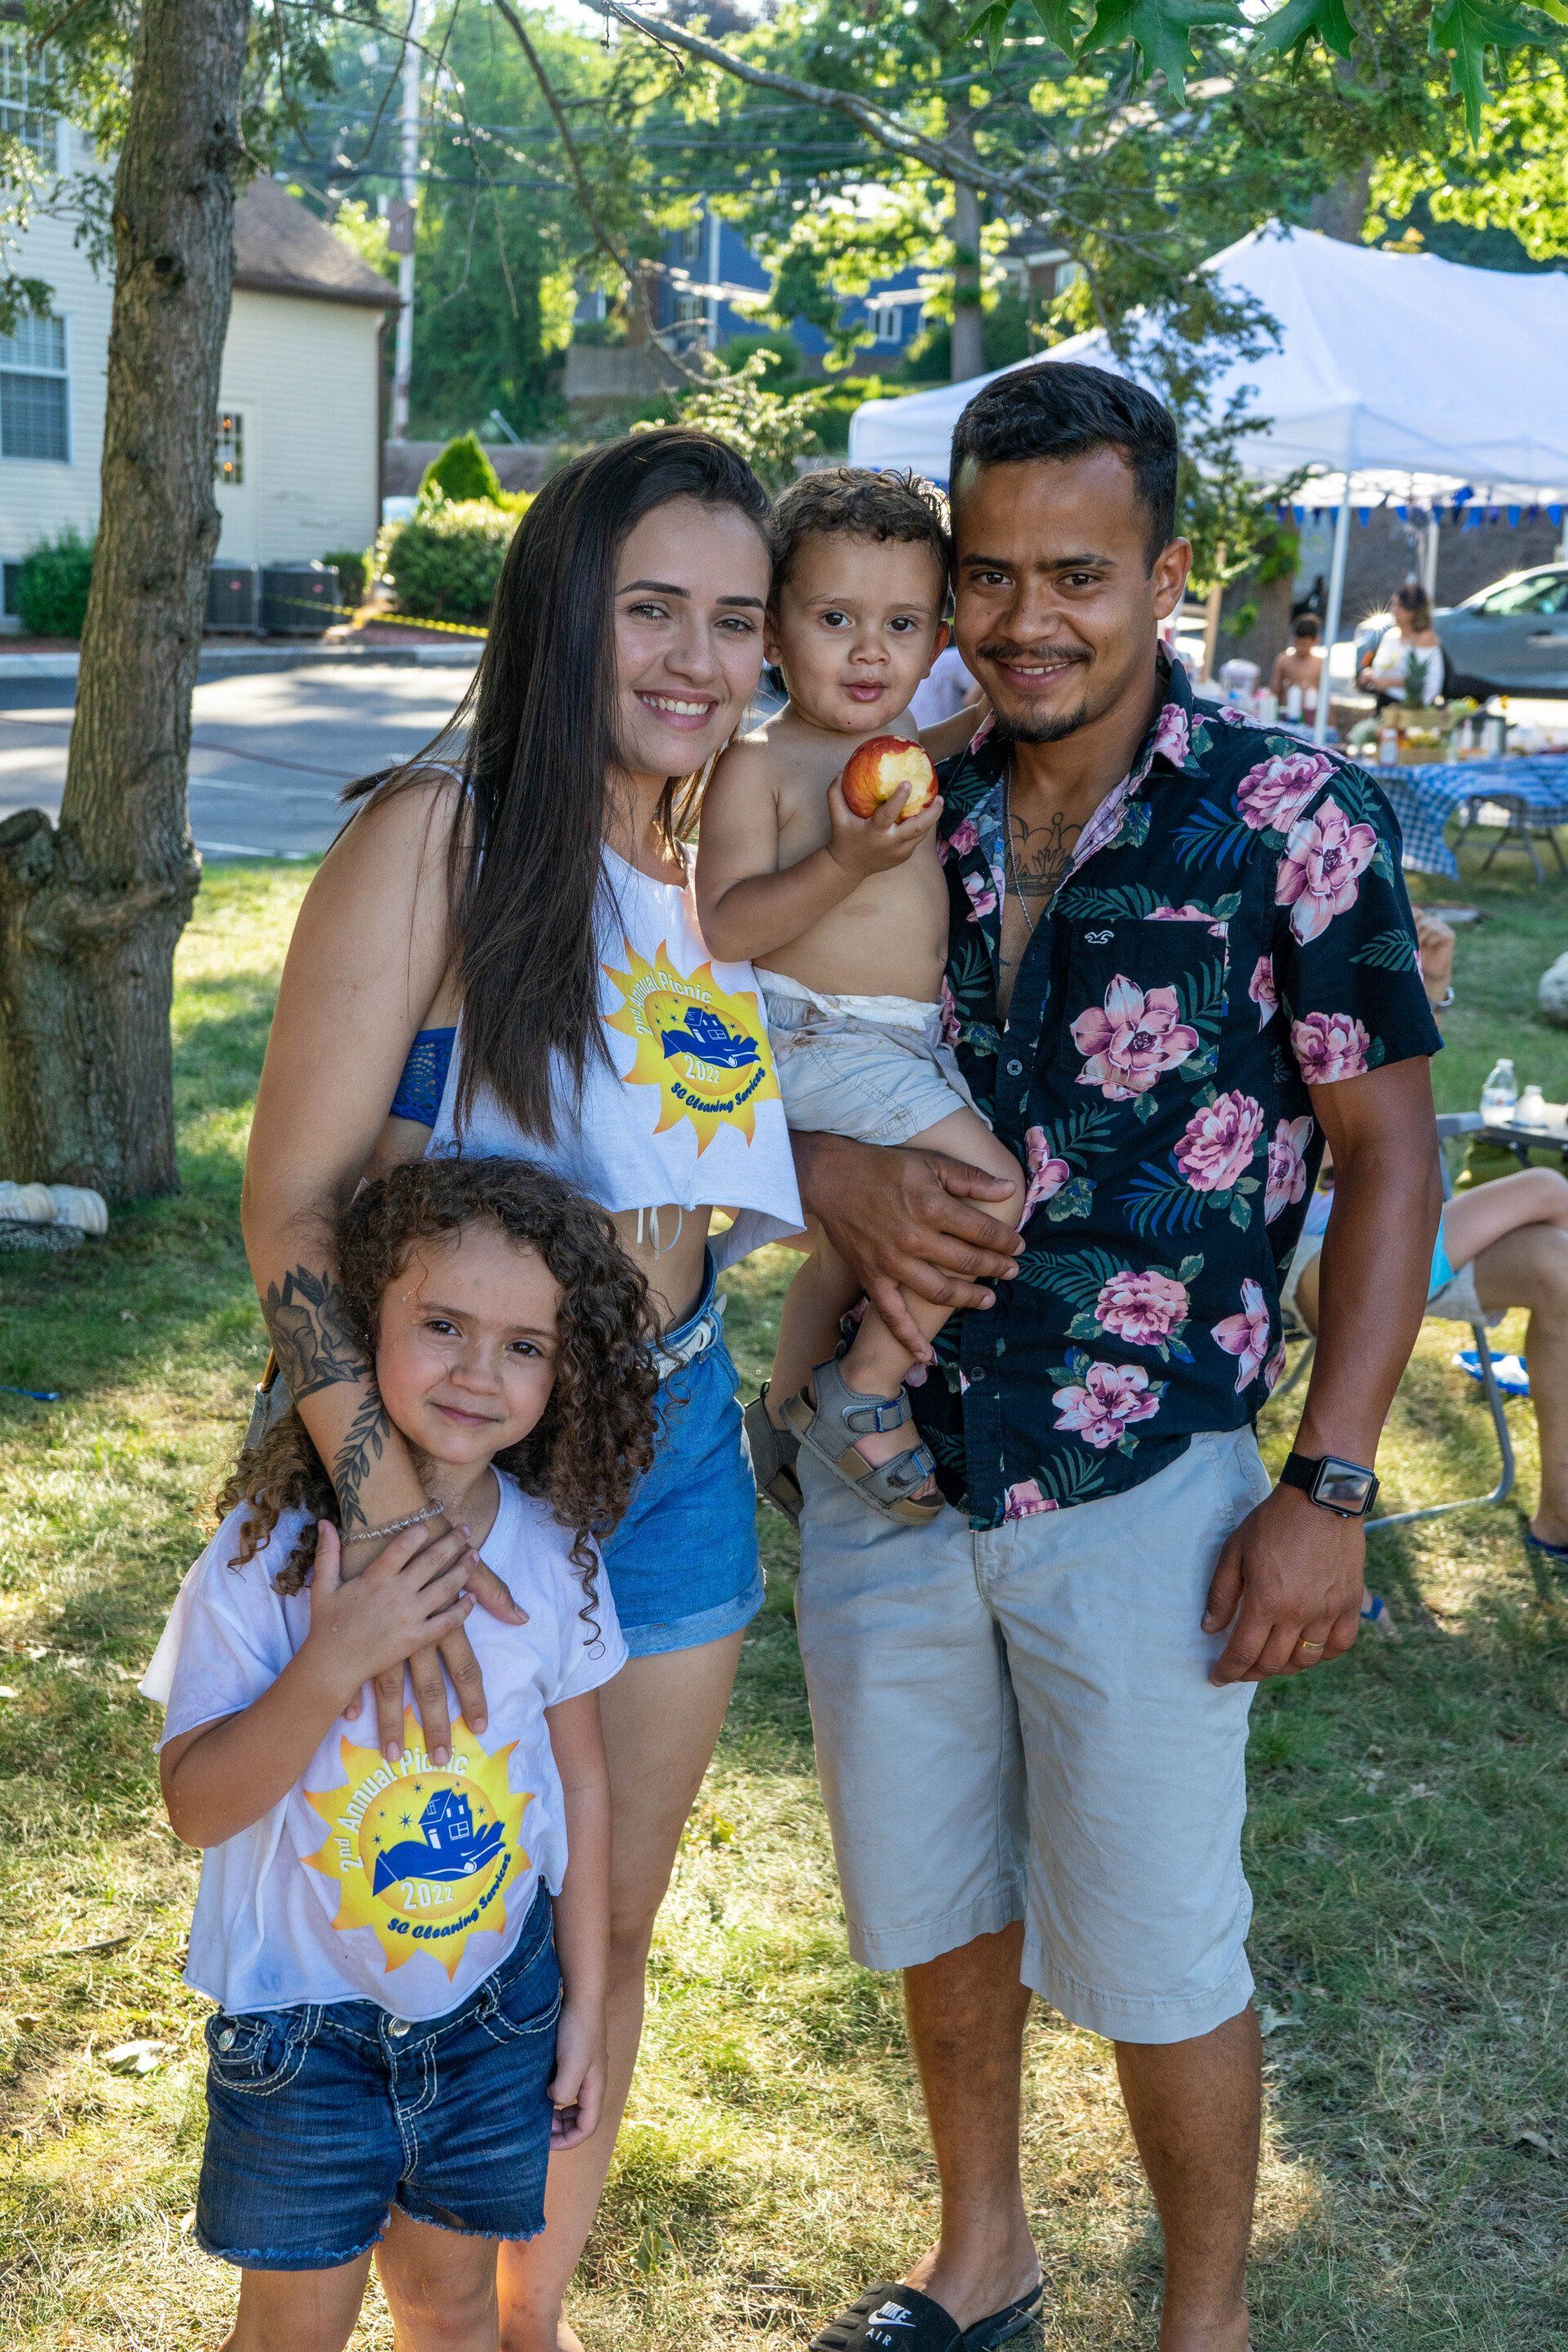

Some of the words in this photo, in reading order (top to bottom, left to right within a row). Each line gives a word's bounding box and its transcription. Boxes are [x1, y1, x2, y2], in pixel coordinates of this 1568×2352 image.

[657, 971, 712, 1004] Picnic
[684, 1054, 720, 1084] 2022
[671, 1082, 687, 1099] SC
[685, 1094, 733, 1113] Cleaning
[735, 1067, 765, 1106] Services
[399, 1745, 469, 1777] Picic
[336, 1757, 399, 1835] Annual
[334, 1837, 364, 1873] 2nd
[387, 1917, 410, 1934] SC
[412, 1908, 479, 1939] Cleaning
[479, 1852, 511, 1909] Services
[400, 1881, 453, 1910] 2022
[878, 2301, 912, 2322] NIKE
[865, 2328, 892, 2346] AIR
